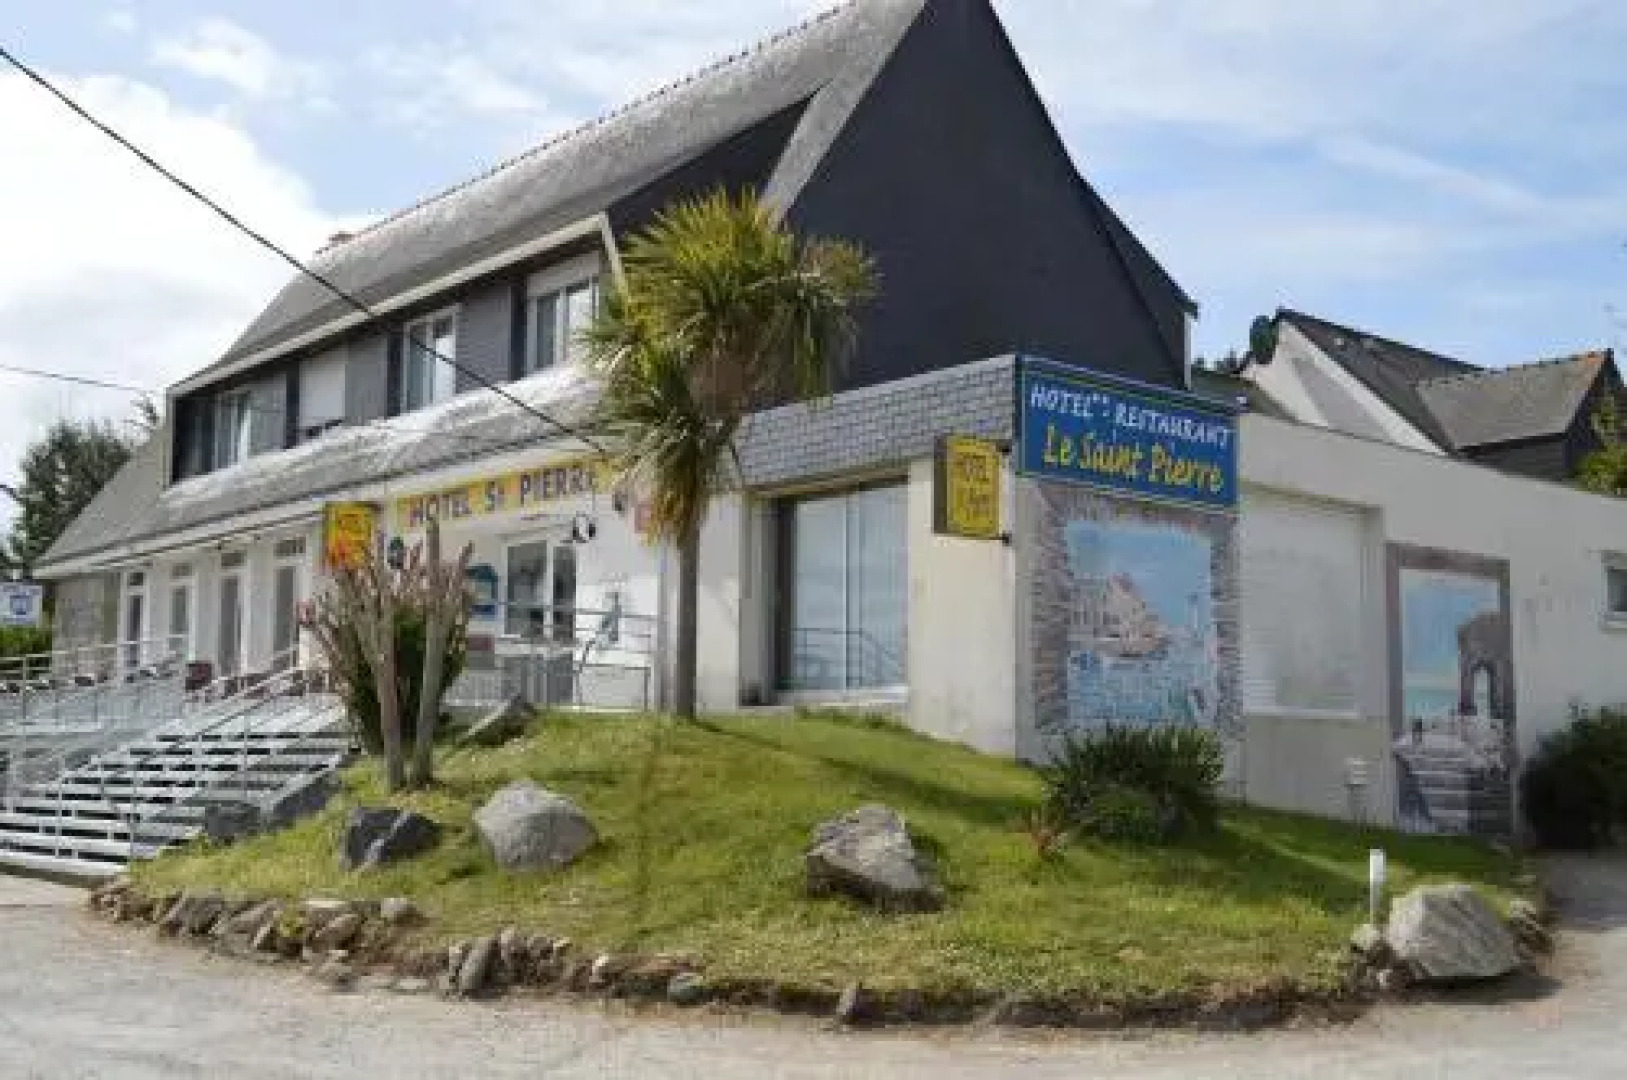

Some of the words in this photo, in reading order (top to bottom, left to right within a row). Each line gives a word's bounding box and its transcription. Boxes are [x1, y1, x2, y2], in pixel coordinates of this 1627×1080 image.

[1115, 403, 1229, 449] RESTAURANT
[1043, 424, 1074, 467] Le
[1079, 431, 1144, 477] Saint
[1149, 443, 1224, 492] Pierre
